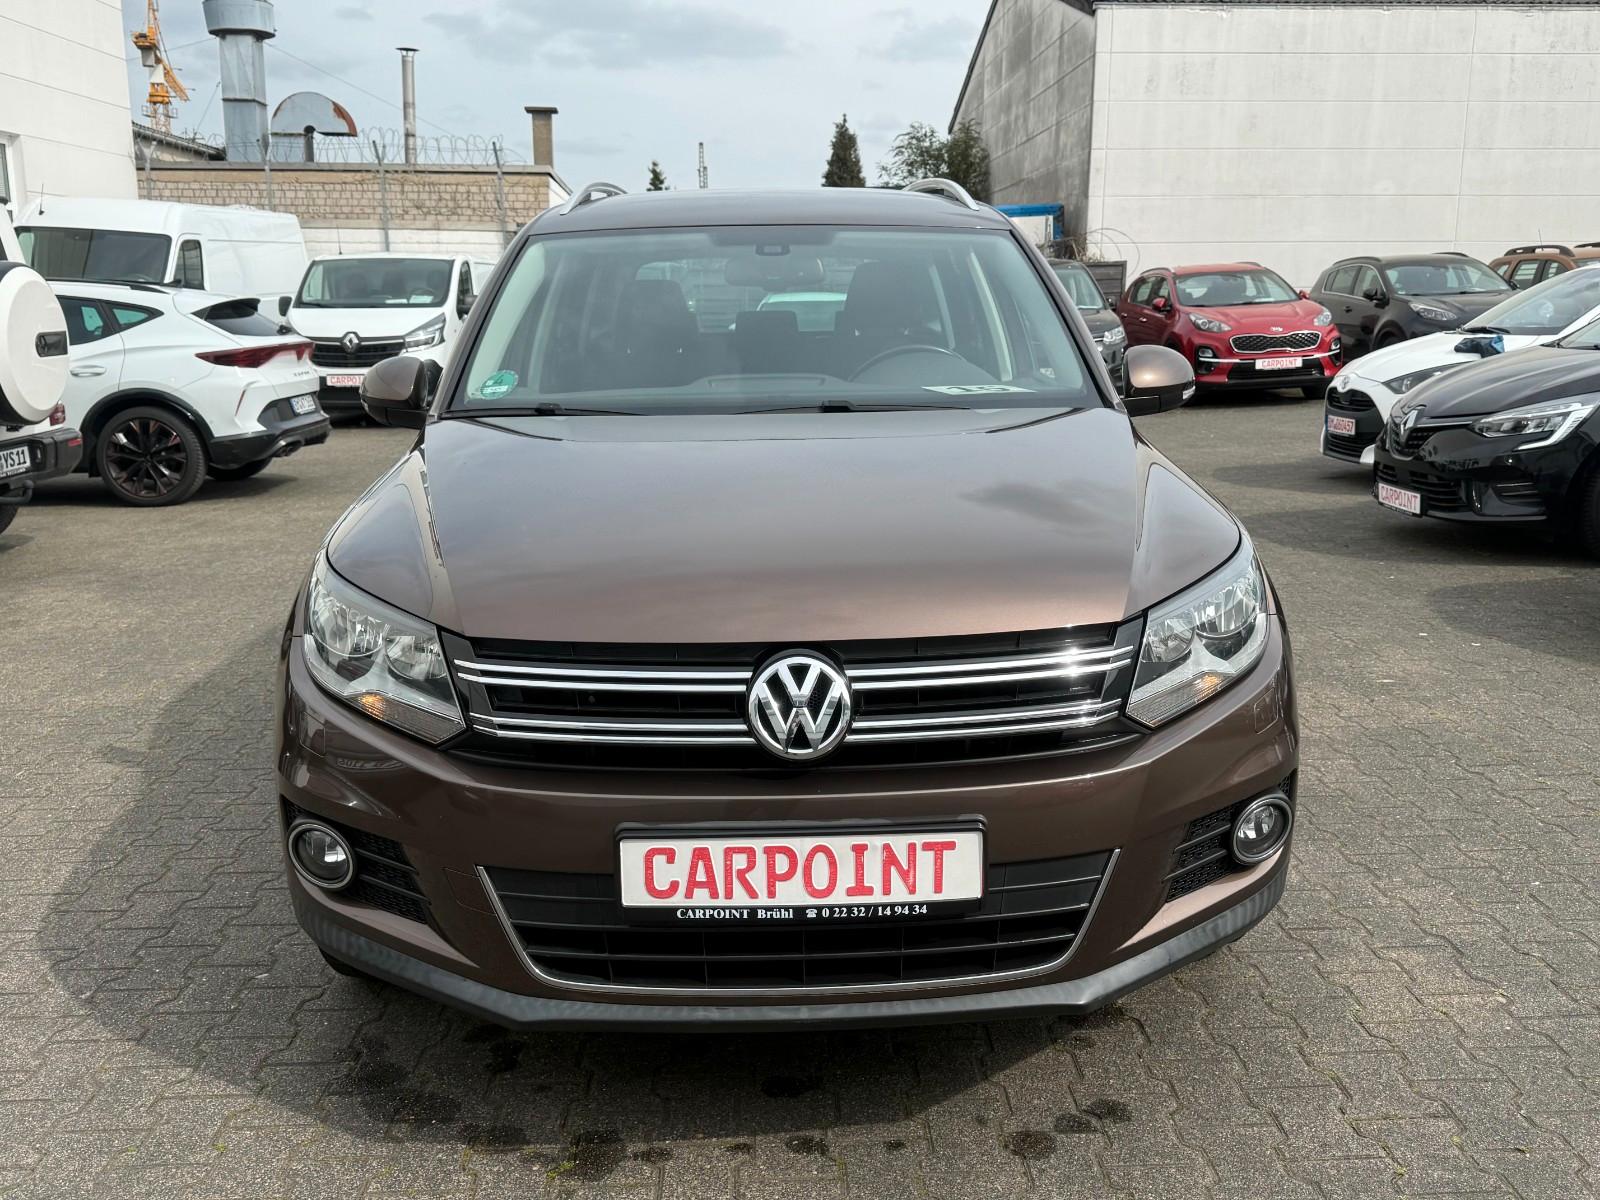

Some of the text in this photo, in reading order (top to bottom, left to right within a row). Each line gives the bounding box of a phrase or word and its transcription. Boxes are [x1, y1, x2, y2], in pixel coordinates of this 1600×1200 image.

[1261, 358, 1298, 368] CARPOINT
[1380, 485, 1419, 512] CARPOINT
[643, 840, 958, 900] CARPOINT
[676, 908, 750, 919] CARPOINT
[757, 908, 793, 919] Brühl
[821, 907, 830, 918] 0
[833, 907, 848, 917] 22
[850, 906, 866, 917] 32
[877, 905, 892, 916] 14
[894, 905, 909, 916] 94
[912, 904, 928, 915] 34
